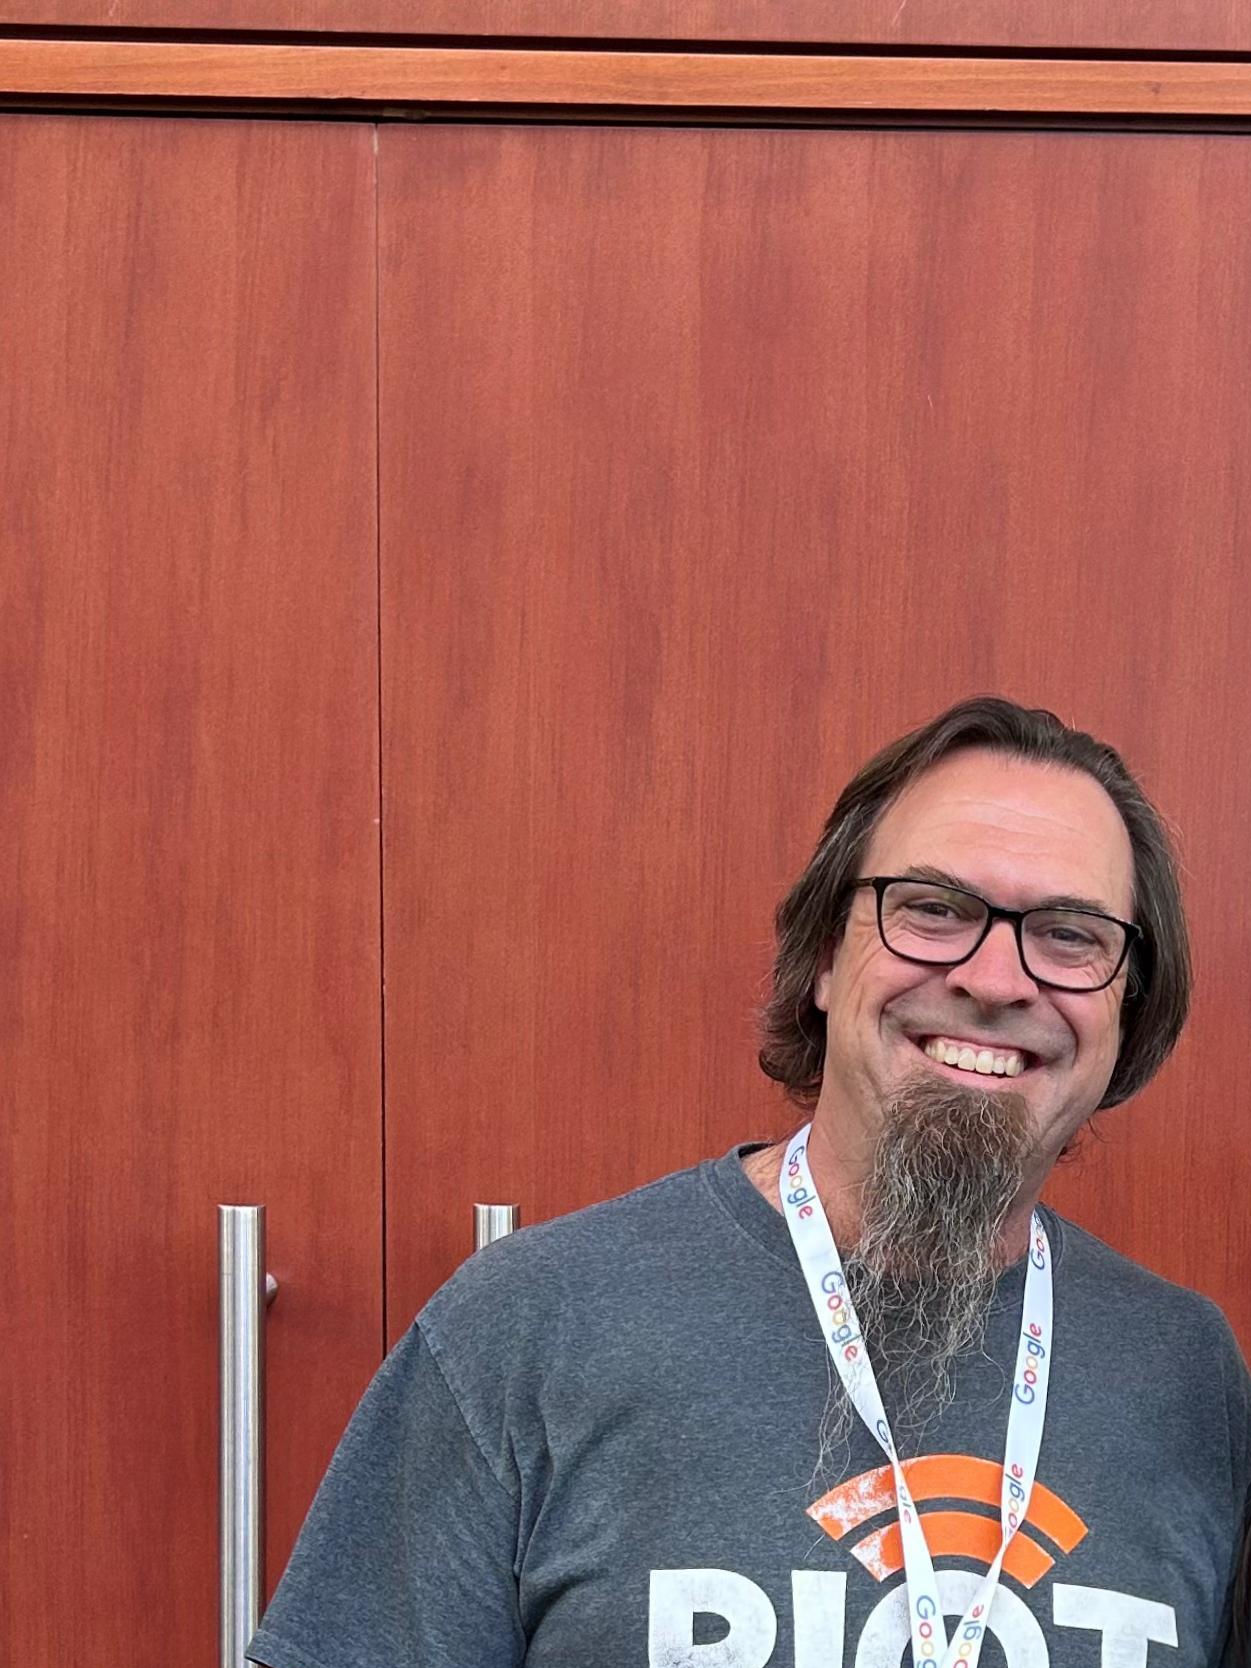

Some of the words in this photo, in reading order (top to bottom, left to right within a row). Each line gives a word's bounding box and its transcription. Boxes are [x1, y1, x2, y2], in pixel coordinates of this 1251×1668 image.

[787, 1145, 816, 1220] Google
[821, 1271, 862, 1362] Google
[1013, 1322, 1046, 1405] Google
